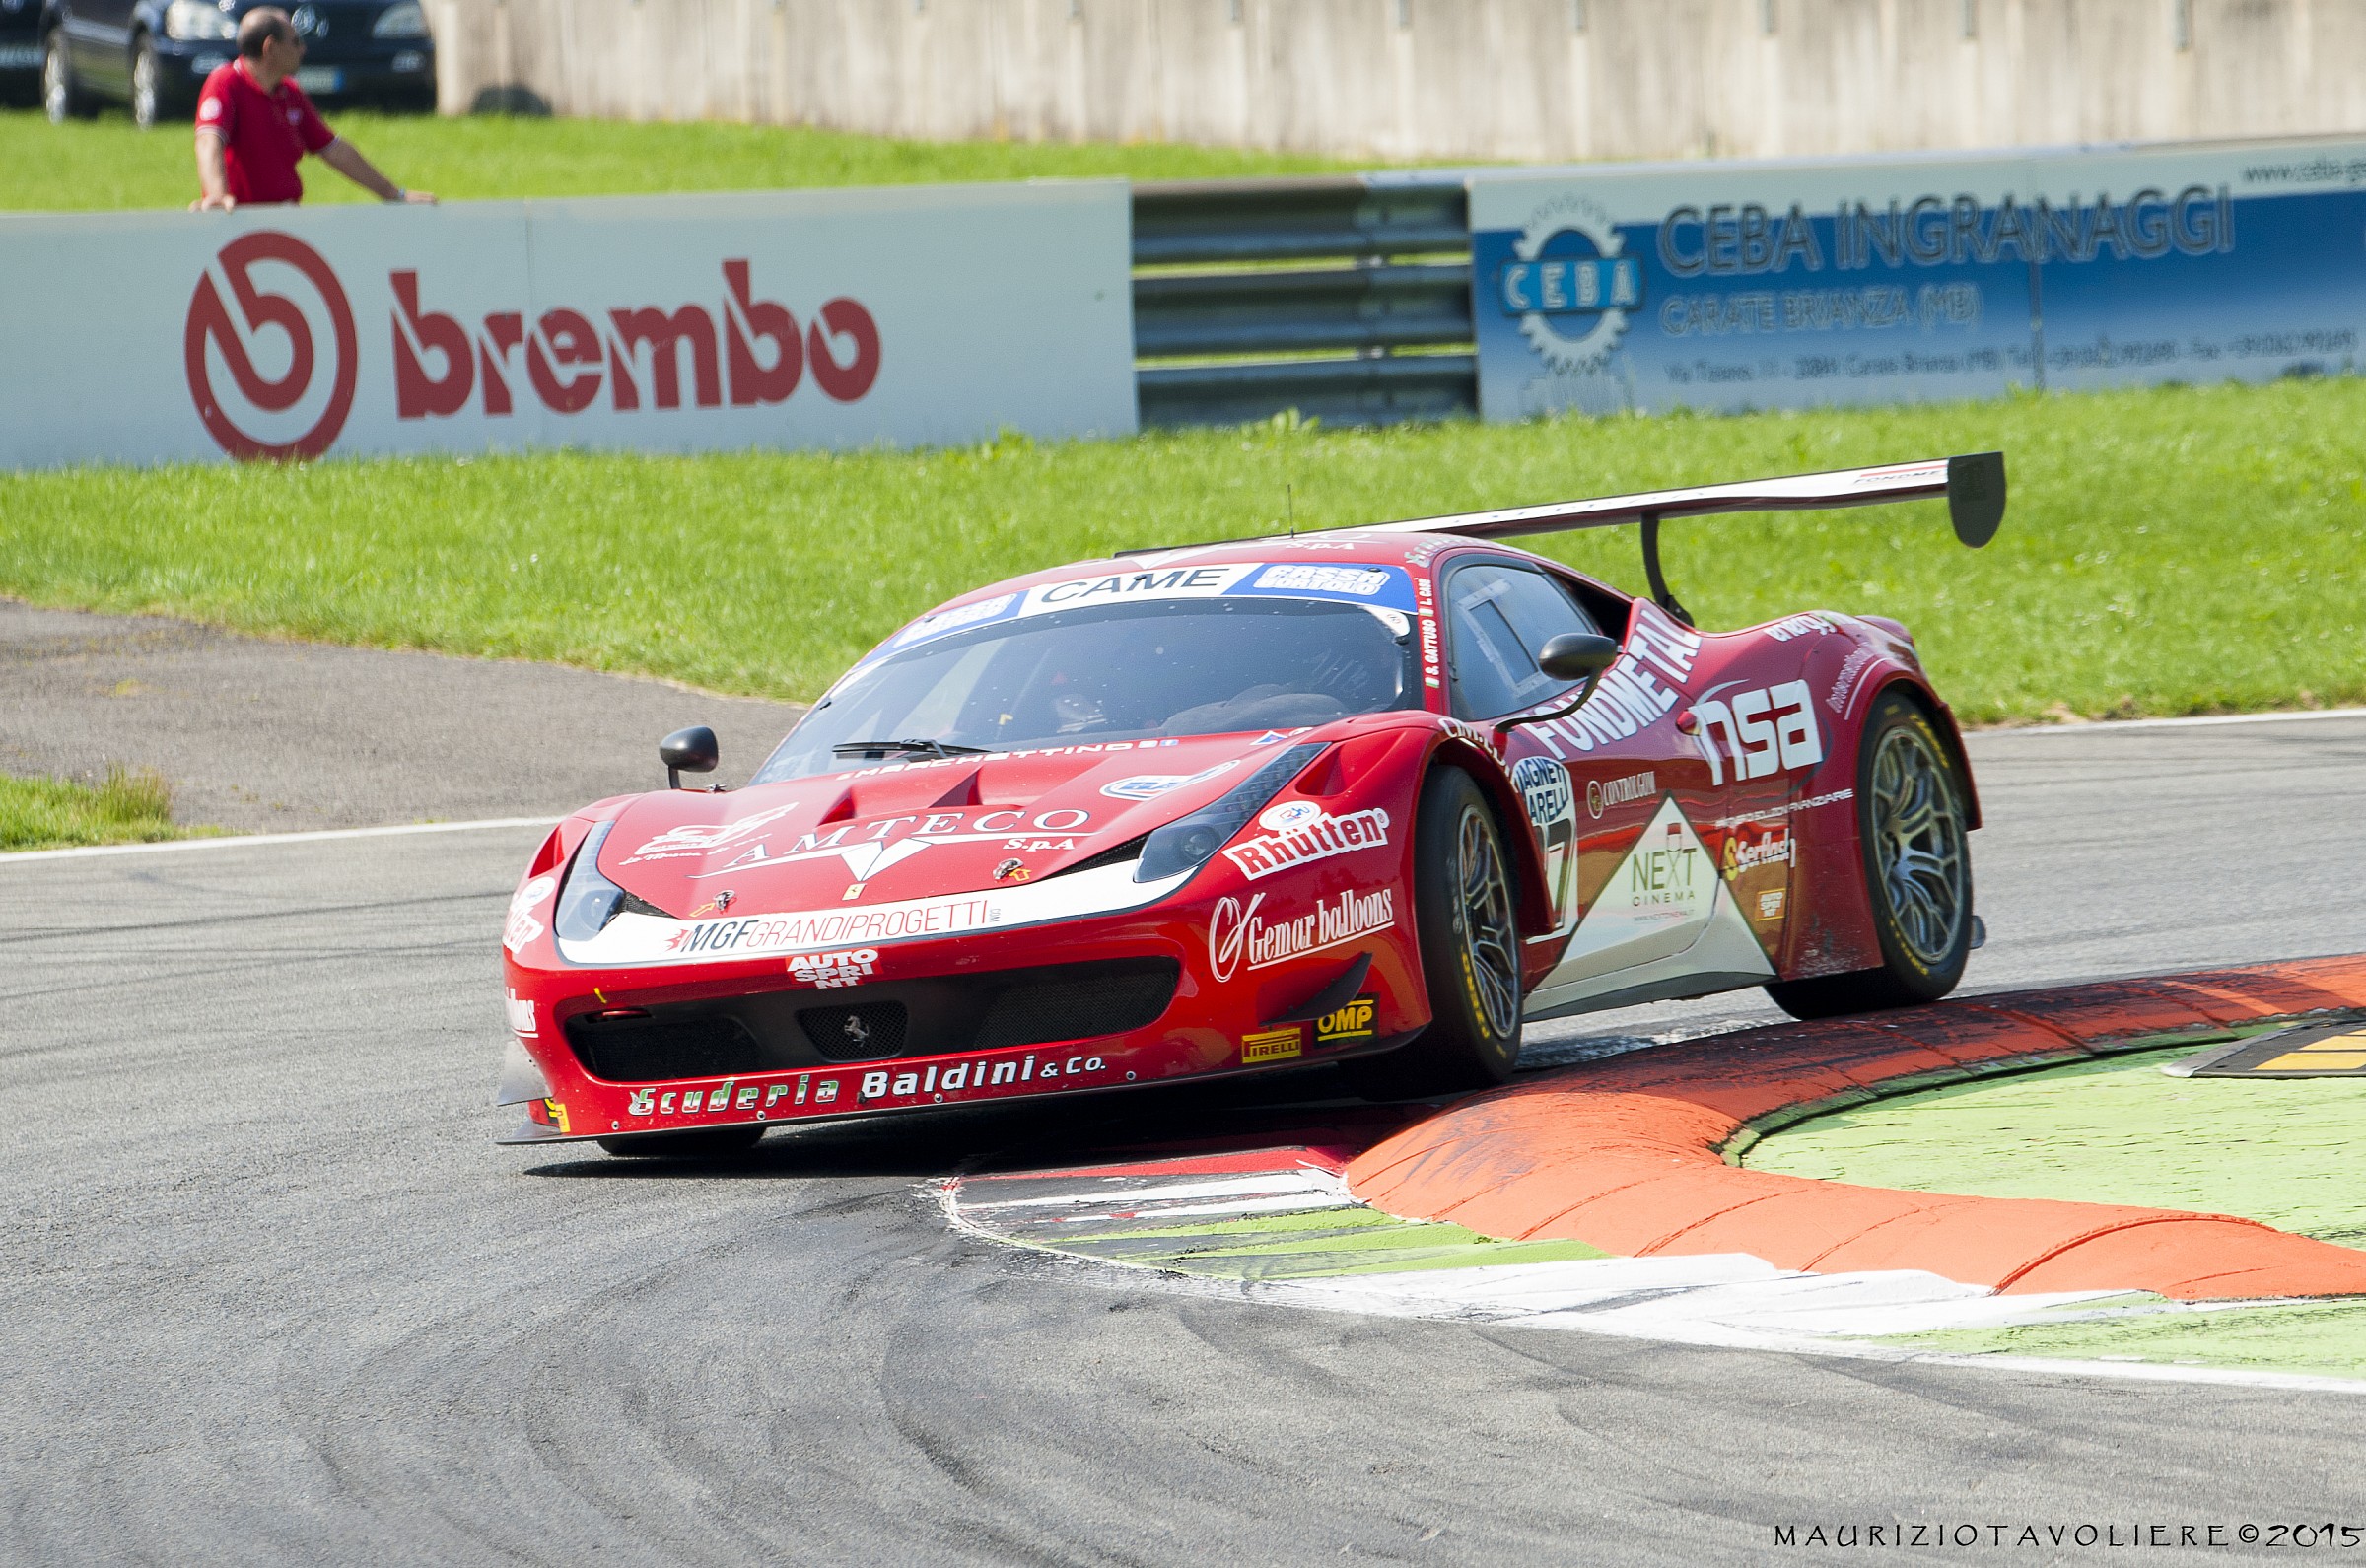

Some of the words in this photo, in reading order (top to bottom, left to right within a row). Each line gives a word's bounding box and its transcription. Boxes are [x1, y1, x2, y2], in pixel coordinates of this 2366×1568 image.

[1660, 204, 1824, 276] CEBA
[1838, 184, 2235, 268] INGRANAGGI
[1505, 262, 1637, 308] CEBA
[389, 258, 881, 420] brembo
[1041, 568, 1231, 603] CAME
[1265, 565, 1388, 584] FASSA
[1422, 619, 1439, 664] GATTUSO
[1524, 787, 1569, 823] ARELLI
[723, 808, 1091, 868] AMTECO
[1532, 817, 1571, 930] 7
[1632, 847, 1698, 893] NEXT
[1633, 889, 1696, 907] CINEMA
[1248, 914, 1316, 965] Gemar
[1316, 888, 1395, 944] balloons
[787, 948, 879, 972] AUTO
[793, 962, 875, 983] SPRI
[814, 976, 861, 989] NT
[1317, 1005, 1373, 1034] OMP
[1243, 1035, 1301, 1059] PIRELLI
[628, 1073, 840, 1116] Scuderia
[860, 1055, 1036, 1099] Baldini
[1040, 1062, 1059, 1078] &
[1065, 1056, 1106, 1075] Co.
